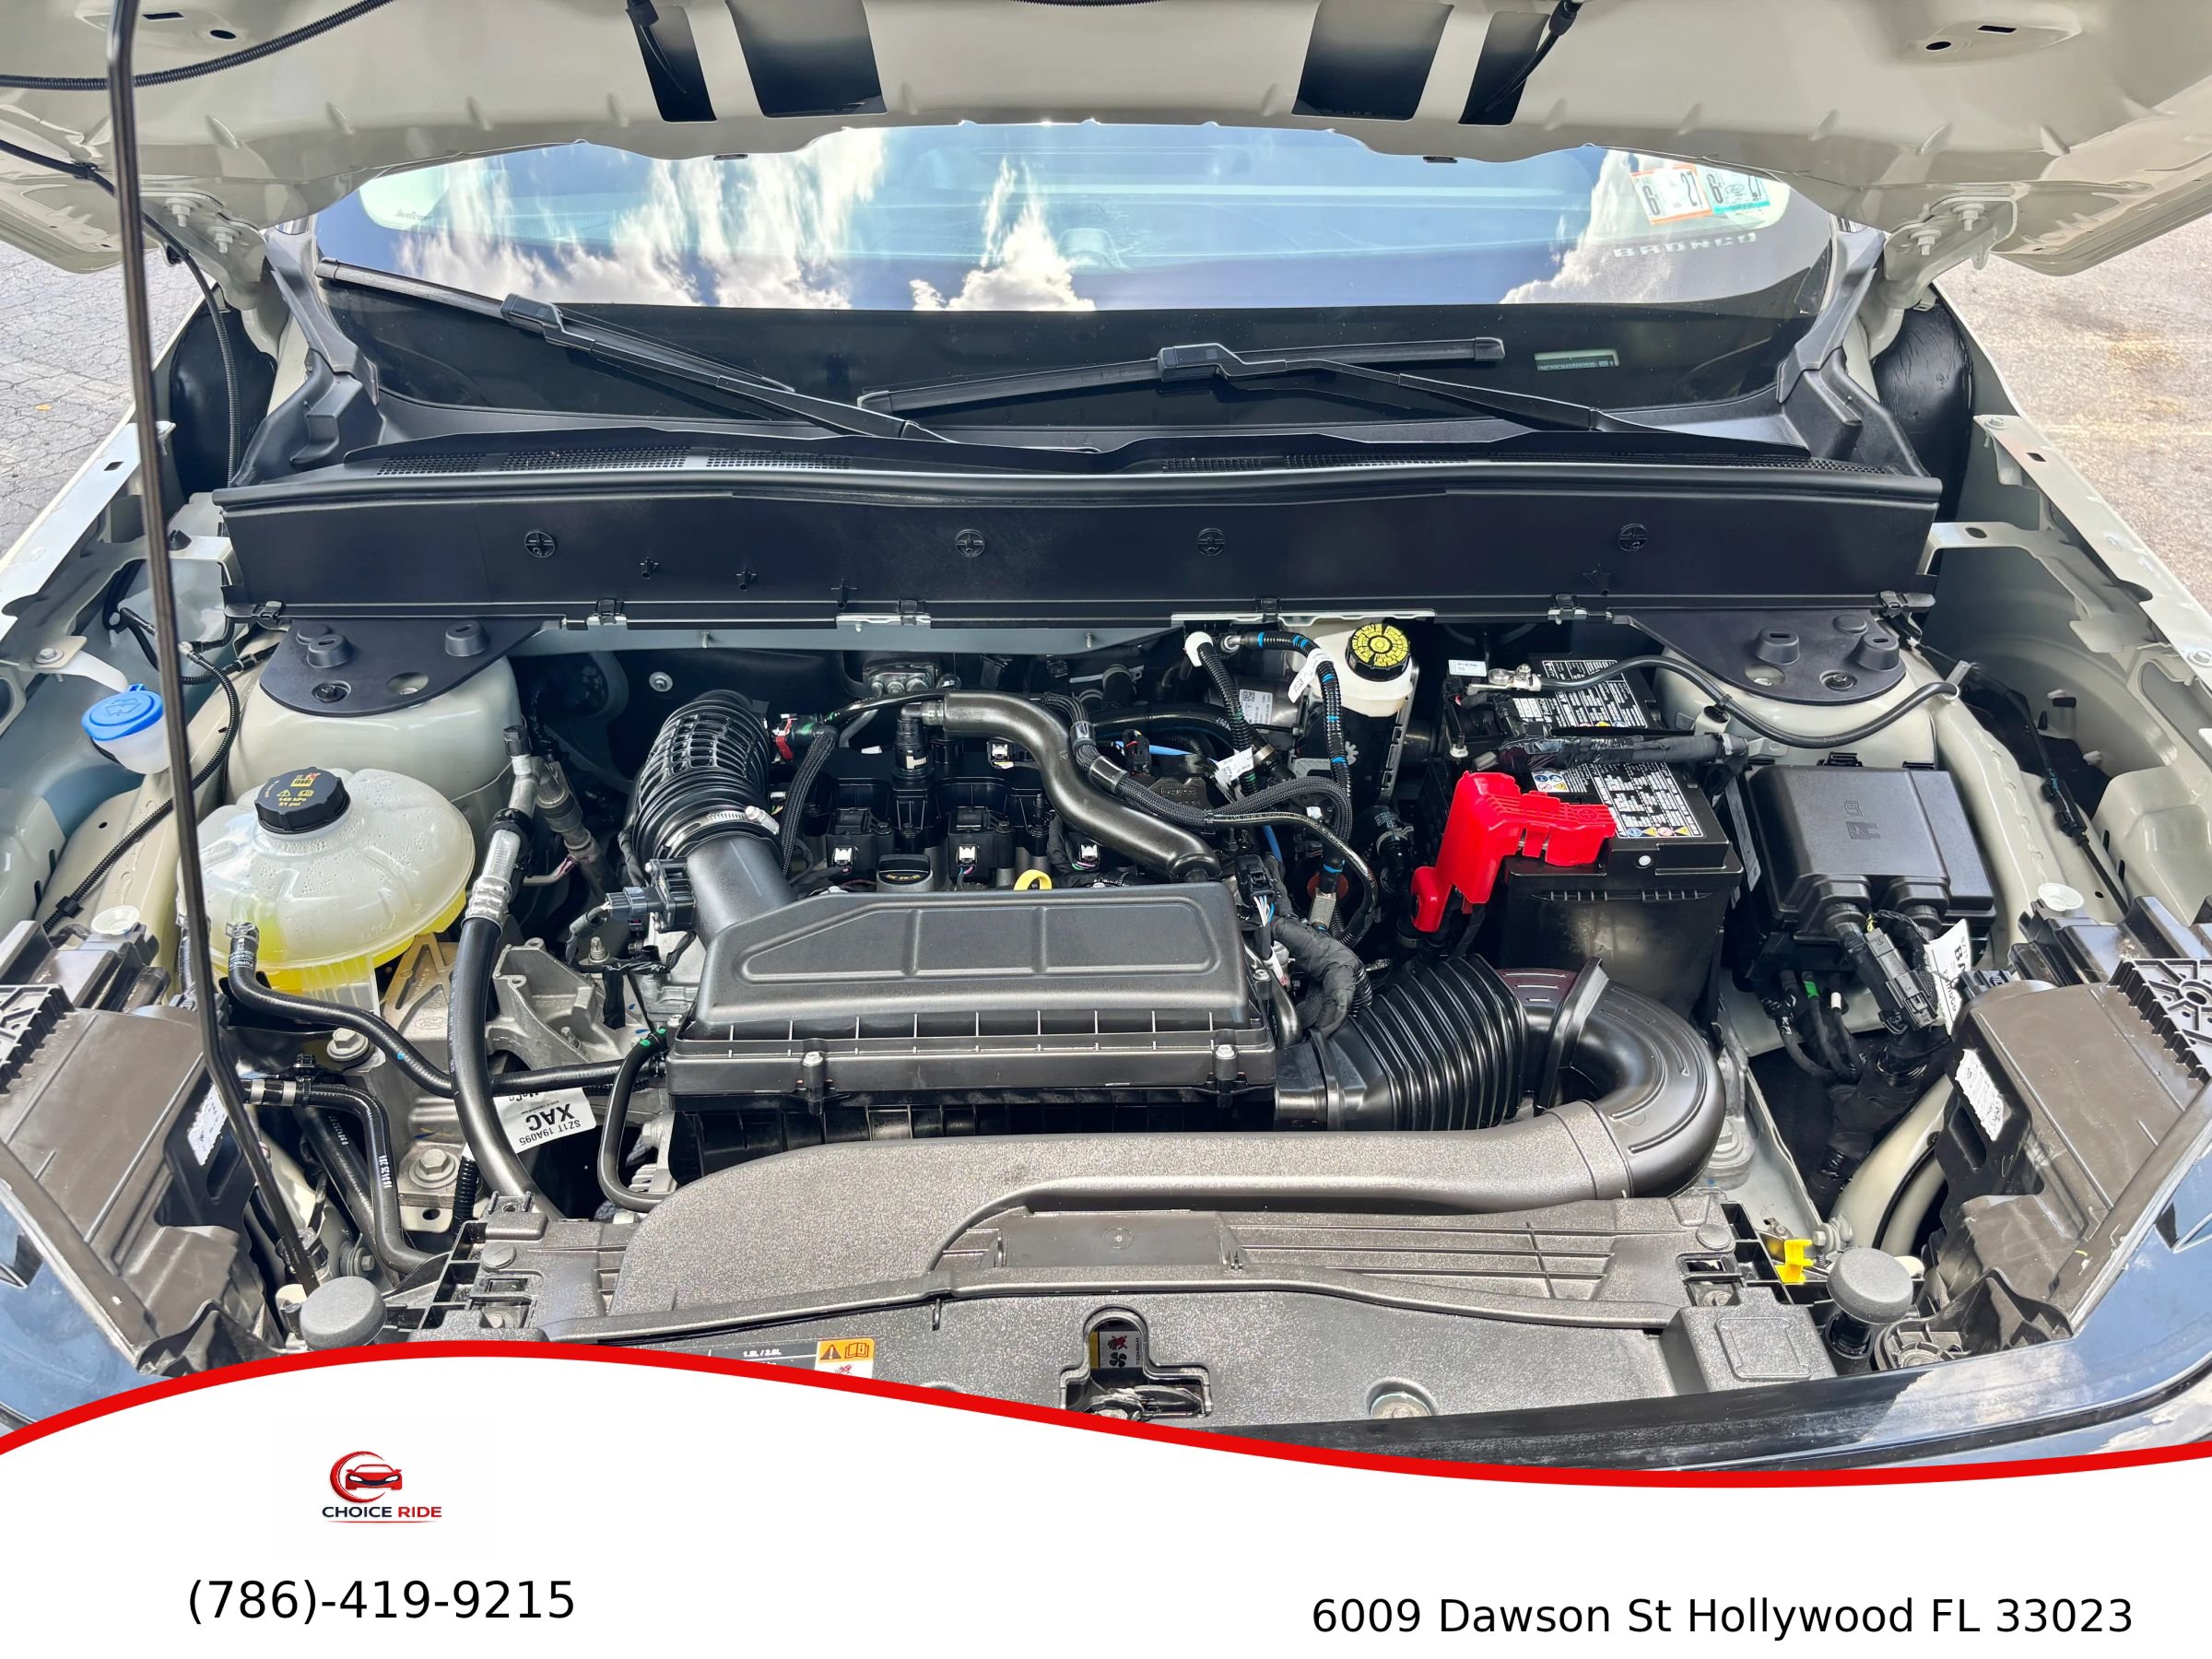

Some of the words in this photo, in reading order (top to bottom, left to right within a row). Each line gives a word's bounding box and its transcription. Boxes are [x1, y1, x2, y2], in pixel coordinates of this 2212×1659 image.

[1613, 231, 1757, 258] BRONCO
[525, 1102, 575, 1132] XAC
[558, 1119, 582, 1133] SZ1T
[519, 1126, 555, 1147] 19A095
